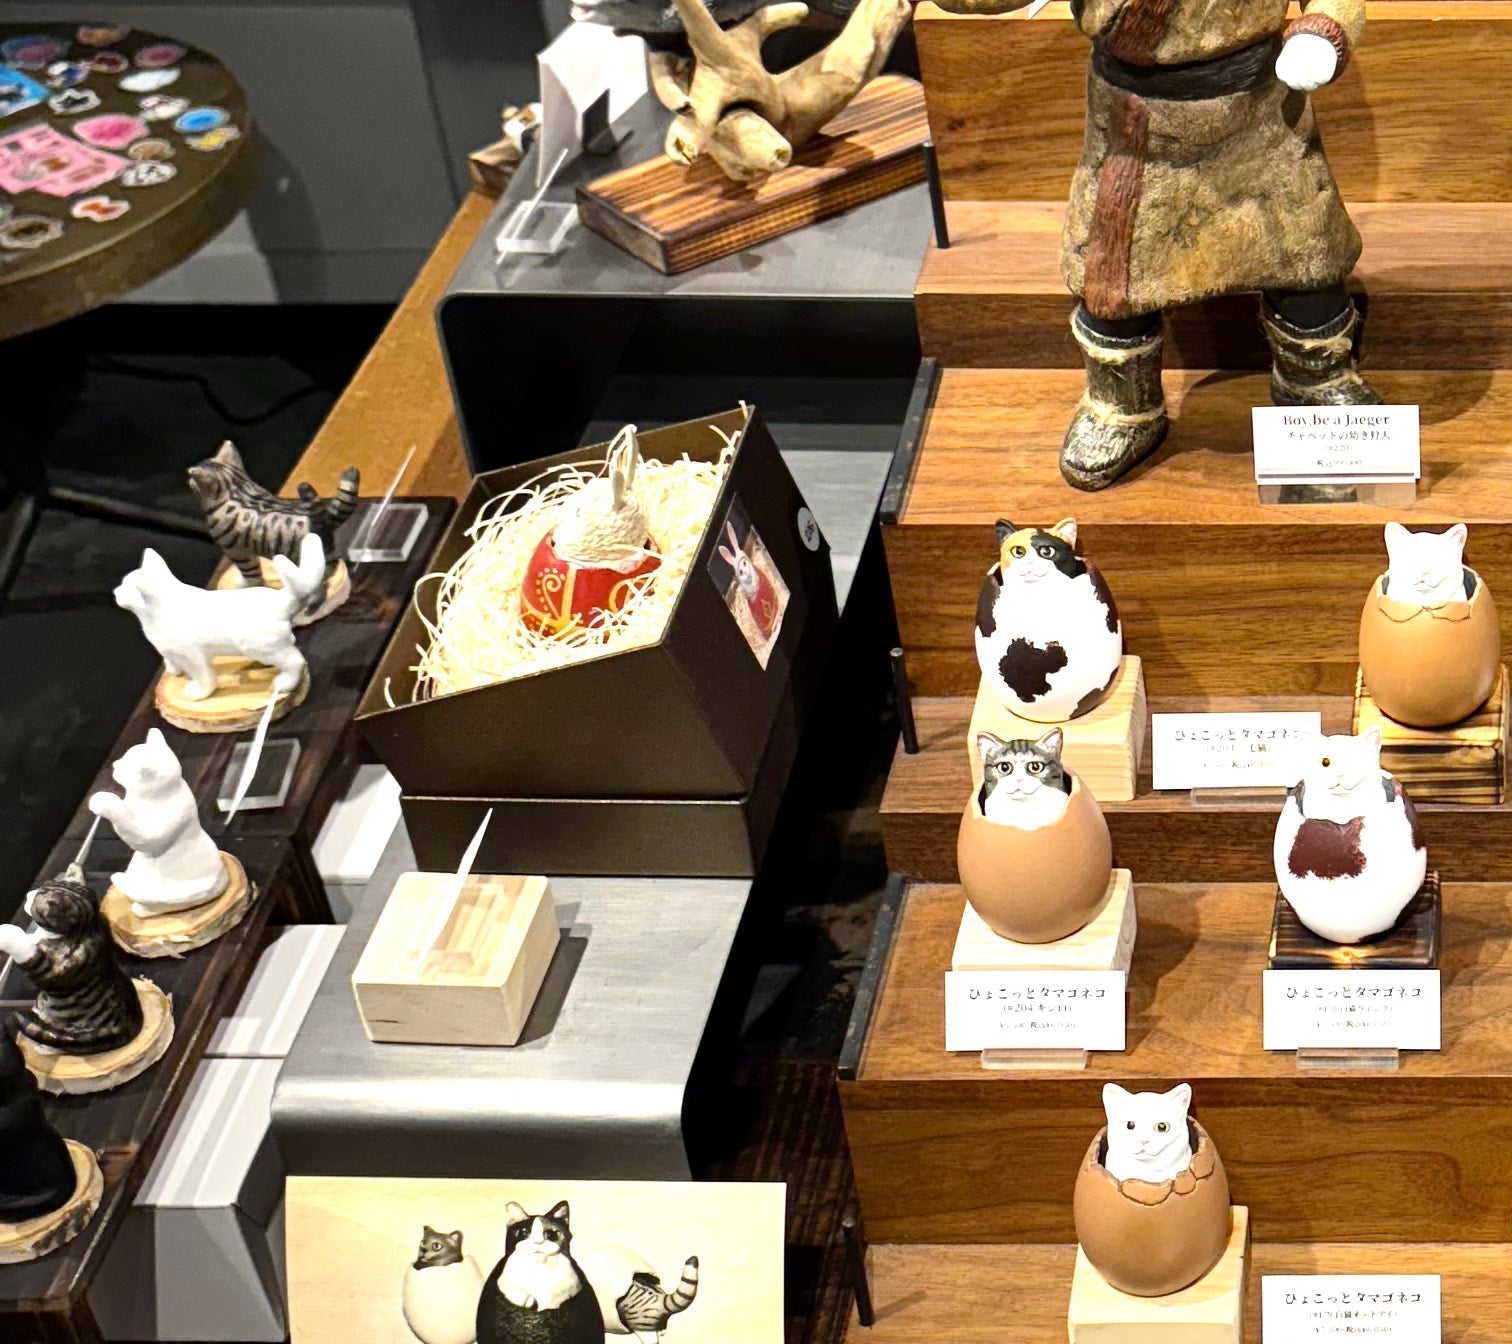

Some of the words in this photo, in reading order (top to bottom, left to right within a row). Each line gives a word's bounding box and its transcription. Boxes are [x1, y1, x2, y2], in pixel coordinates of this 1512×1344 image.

[968, 987, 1106, 1000] ひょこっとタマゴネコ
[1286, 986, 1421, 999] ひょこっとタマゴネコ
[1285, 1292, 1421, 1305] ひょこっとタマゴネコ
